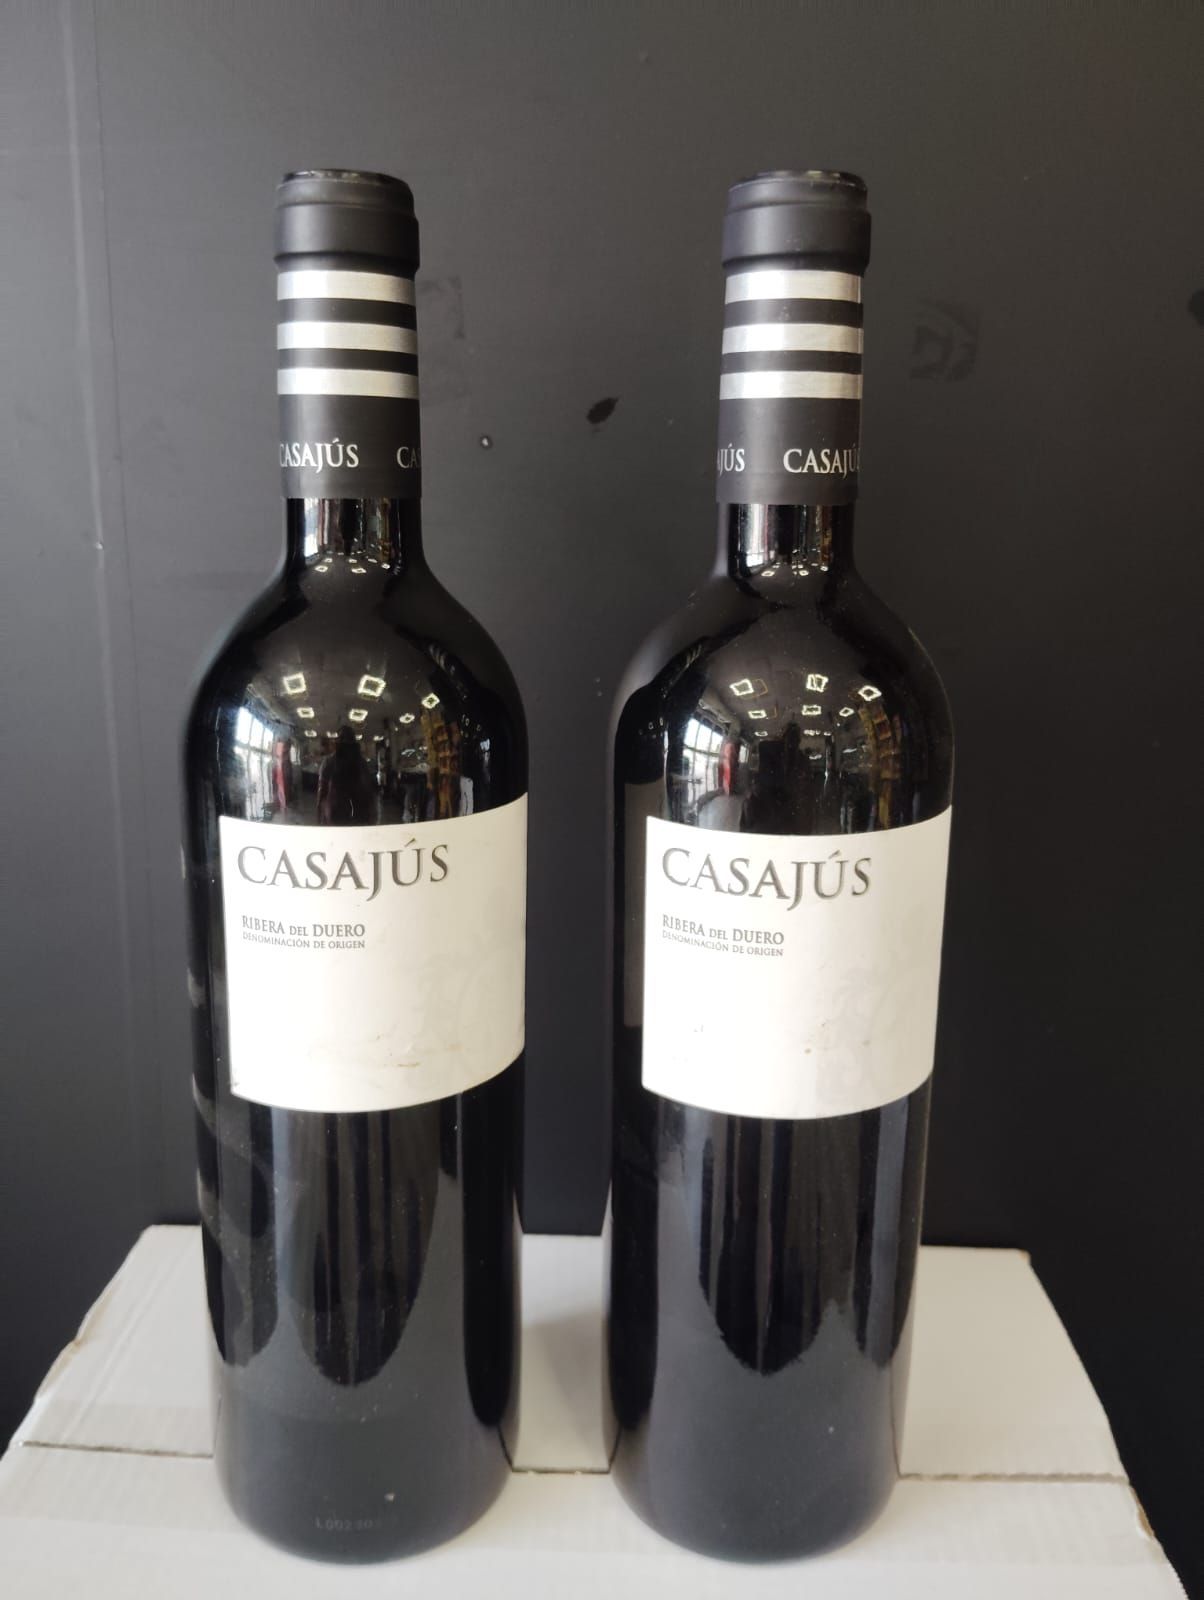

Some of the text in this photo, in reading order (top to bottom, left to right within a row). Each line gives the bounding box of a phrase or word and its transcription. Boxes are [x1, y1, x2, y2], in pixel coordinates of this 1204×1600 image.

[279, 437, 360, 474] CASAJÚS
[396, 446, 421, 469] CA
[783, 442, 860, 479] CASAJÚ
[237, 838, 449, 902] CASAJÚS
[662, 847, 872, 911] CASAJÚS
[242, 915, 365, 938] RIBERA DEL DUERO
[242, 931, 365, 949] DENOMINACIÓN DE ORIGEN
[662, 914, 784, 945] RIBERA DEL DUERO
[662, 930, 784, 957] DENOMINACIÓN DE ORIGEN
